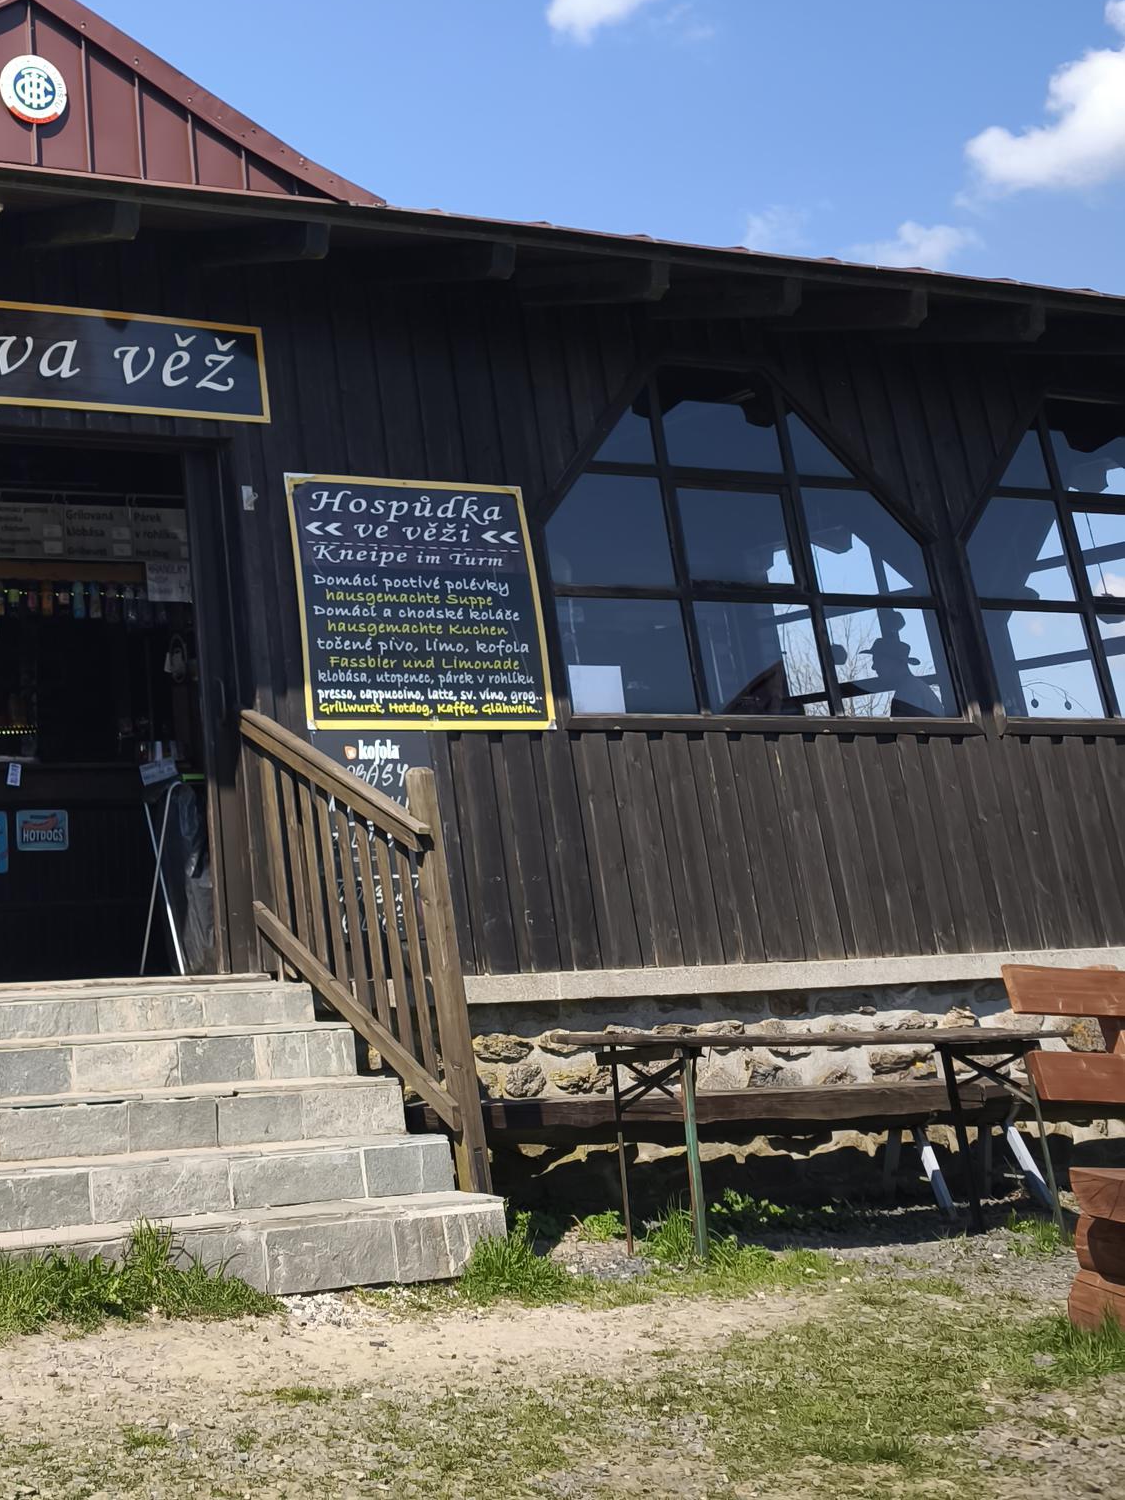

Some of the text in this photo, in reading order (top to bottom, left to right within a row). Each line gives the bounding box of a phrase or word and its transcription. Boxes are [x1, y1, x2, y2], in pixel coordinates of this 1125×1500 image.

[113, 333, 237, 392] věž
[310, 491, 502, 525] Hospůdka
[354, 523, 471, 543] ve věži
[313, 544, 504, 567] Kneipe im Turm
[313, 574, 509, 596] Domácí poctivé polévky
[326, 589, 493, 609] hausgemachte Suppe
[313, 606, 520, 621] Domácí a chodské koláče
[327, 620, 508, 636] hausgemachte Kuchen
[317, 638, 372, 651] točené
[378, 640, 419, 655] pivo,
[476, 641, 529, 653] kofola
[329, 656, 519, 670] Fassbier und Limonade
[317, 670, 534, 688] klobása, utopenec, párek v rohlíku
[317, 688, 356, 702] presso,
[427, 689, 456, 701] latte,
[460, 691, 476, 700] sv.
[319, 702, 385, 714] Grillwurst,
[389, 703, 433, 716] Hotdog,
[437, 703, 478, 716] Kaffee,
[358, 739, 400, 765] kofola
[23, 828, 63, 843] HOTDOGS
